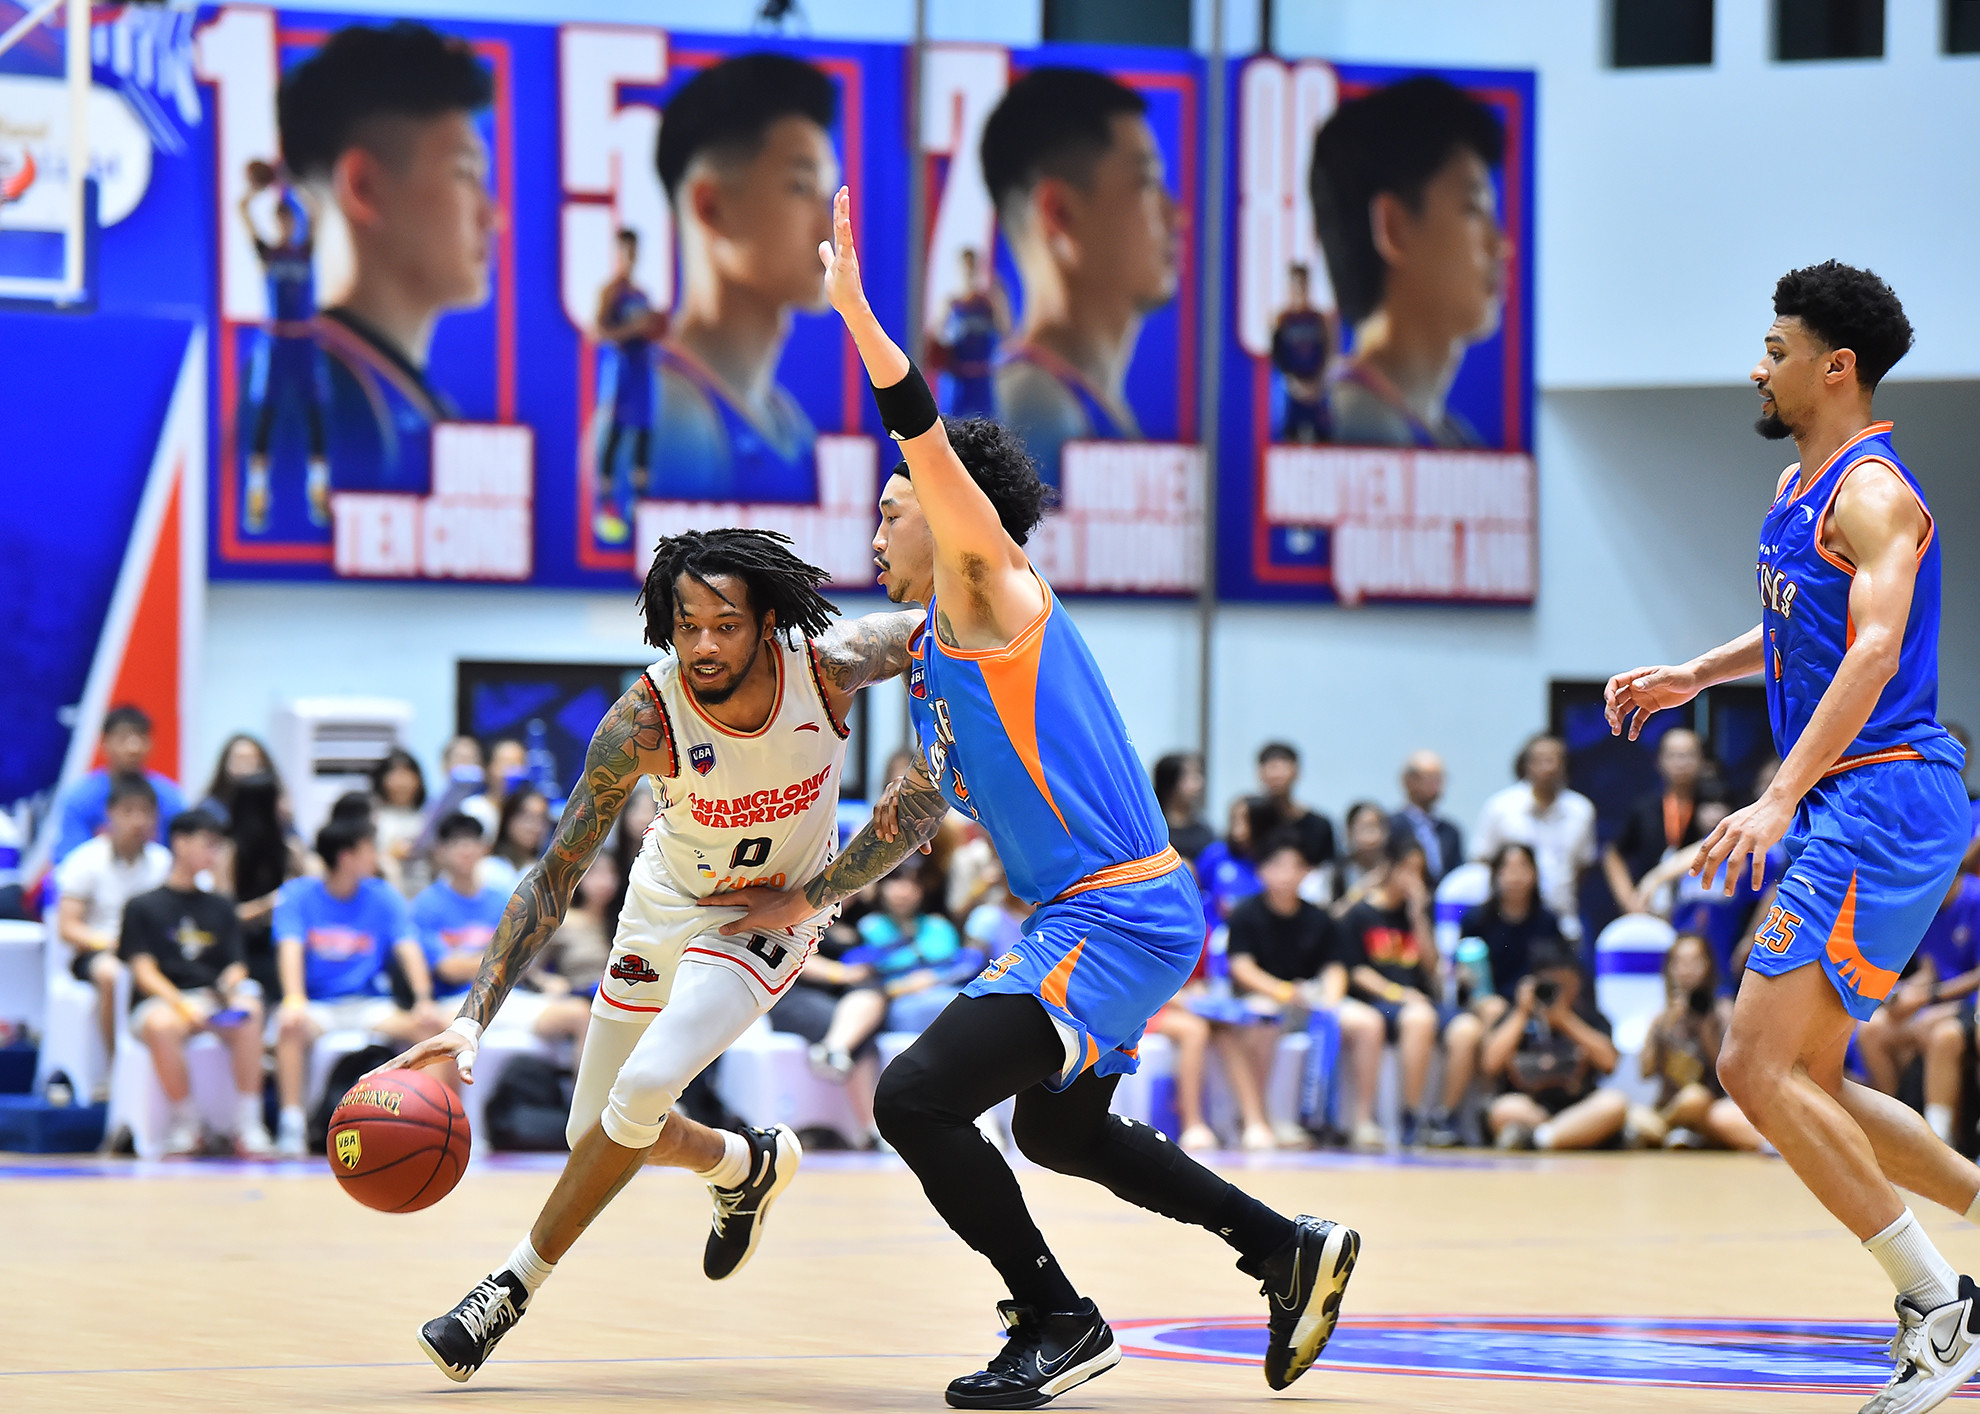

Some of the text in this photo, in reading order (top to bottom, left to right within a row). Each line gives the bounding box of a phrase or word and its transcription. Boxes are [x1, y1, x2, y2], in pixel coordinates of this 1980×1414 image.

[195, 10, 278, 320] 1
[562, 27, 673, 332] 5
[729, 837, 772, 869] 0
[1754, 905, 1804, 955] 25
[979, 952, 1024, 982] 3
[339, 1135, 356, 1148] VBA
